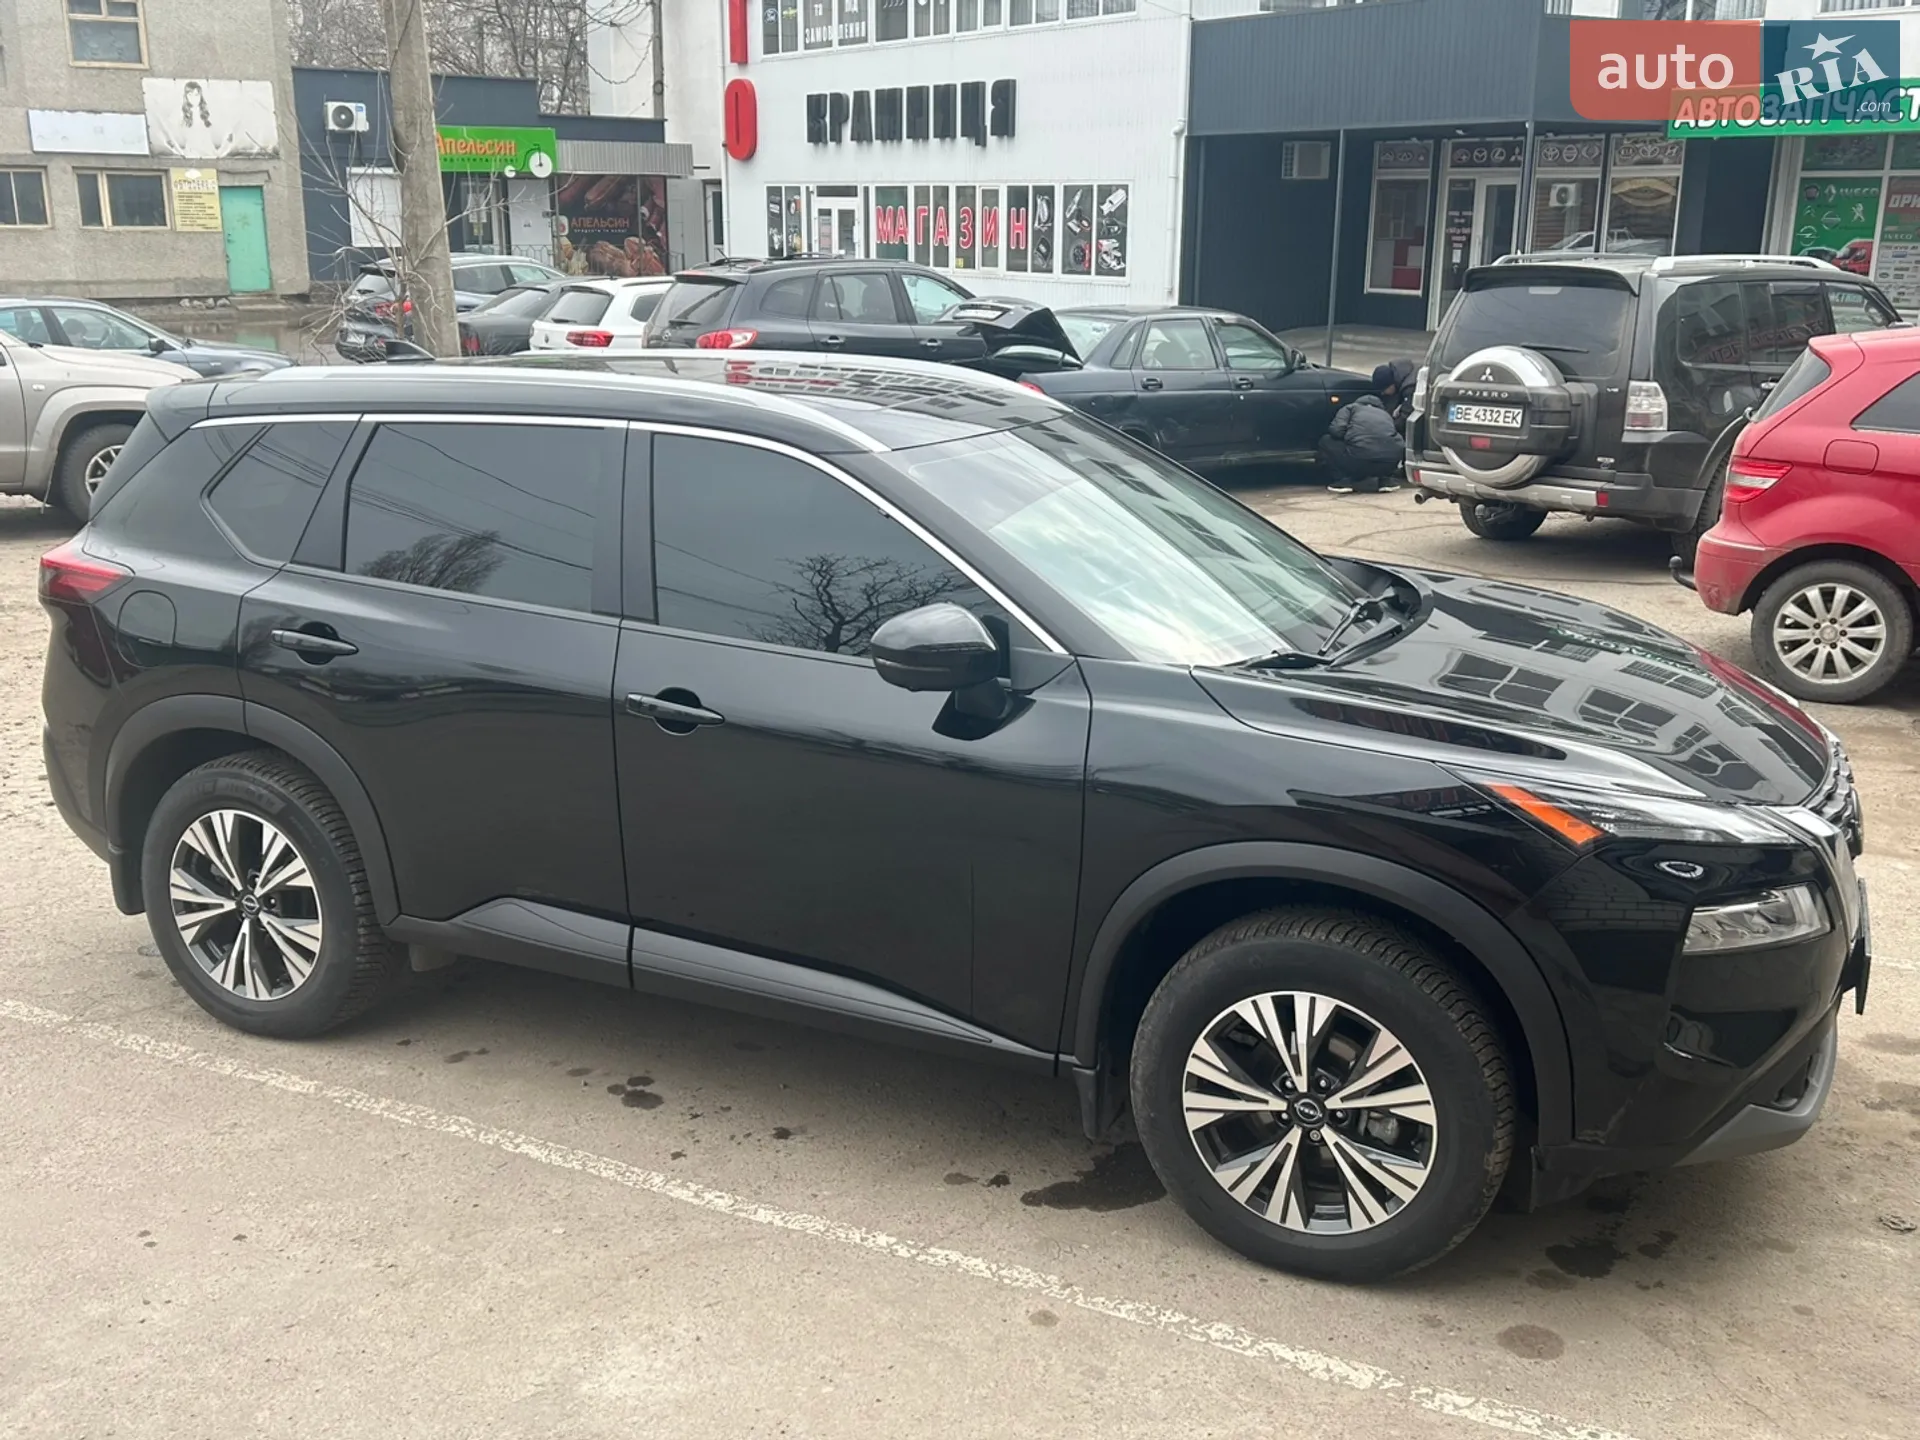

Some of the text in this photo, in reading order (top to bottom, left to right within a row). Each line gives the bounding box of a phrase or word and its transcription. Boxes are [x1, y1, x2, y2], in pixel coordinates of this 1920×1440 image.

[570, 217, 630, 228] АПЕЛЬСИН
[875, 205, 1027, 249] МАГАЗИН
[1458, 389, 1509, 399] PAJERO
[1455, 406, 1521, 425] BE 4332 EK
